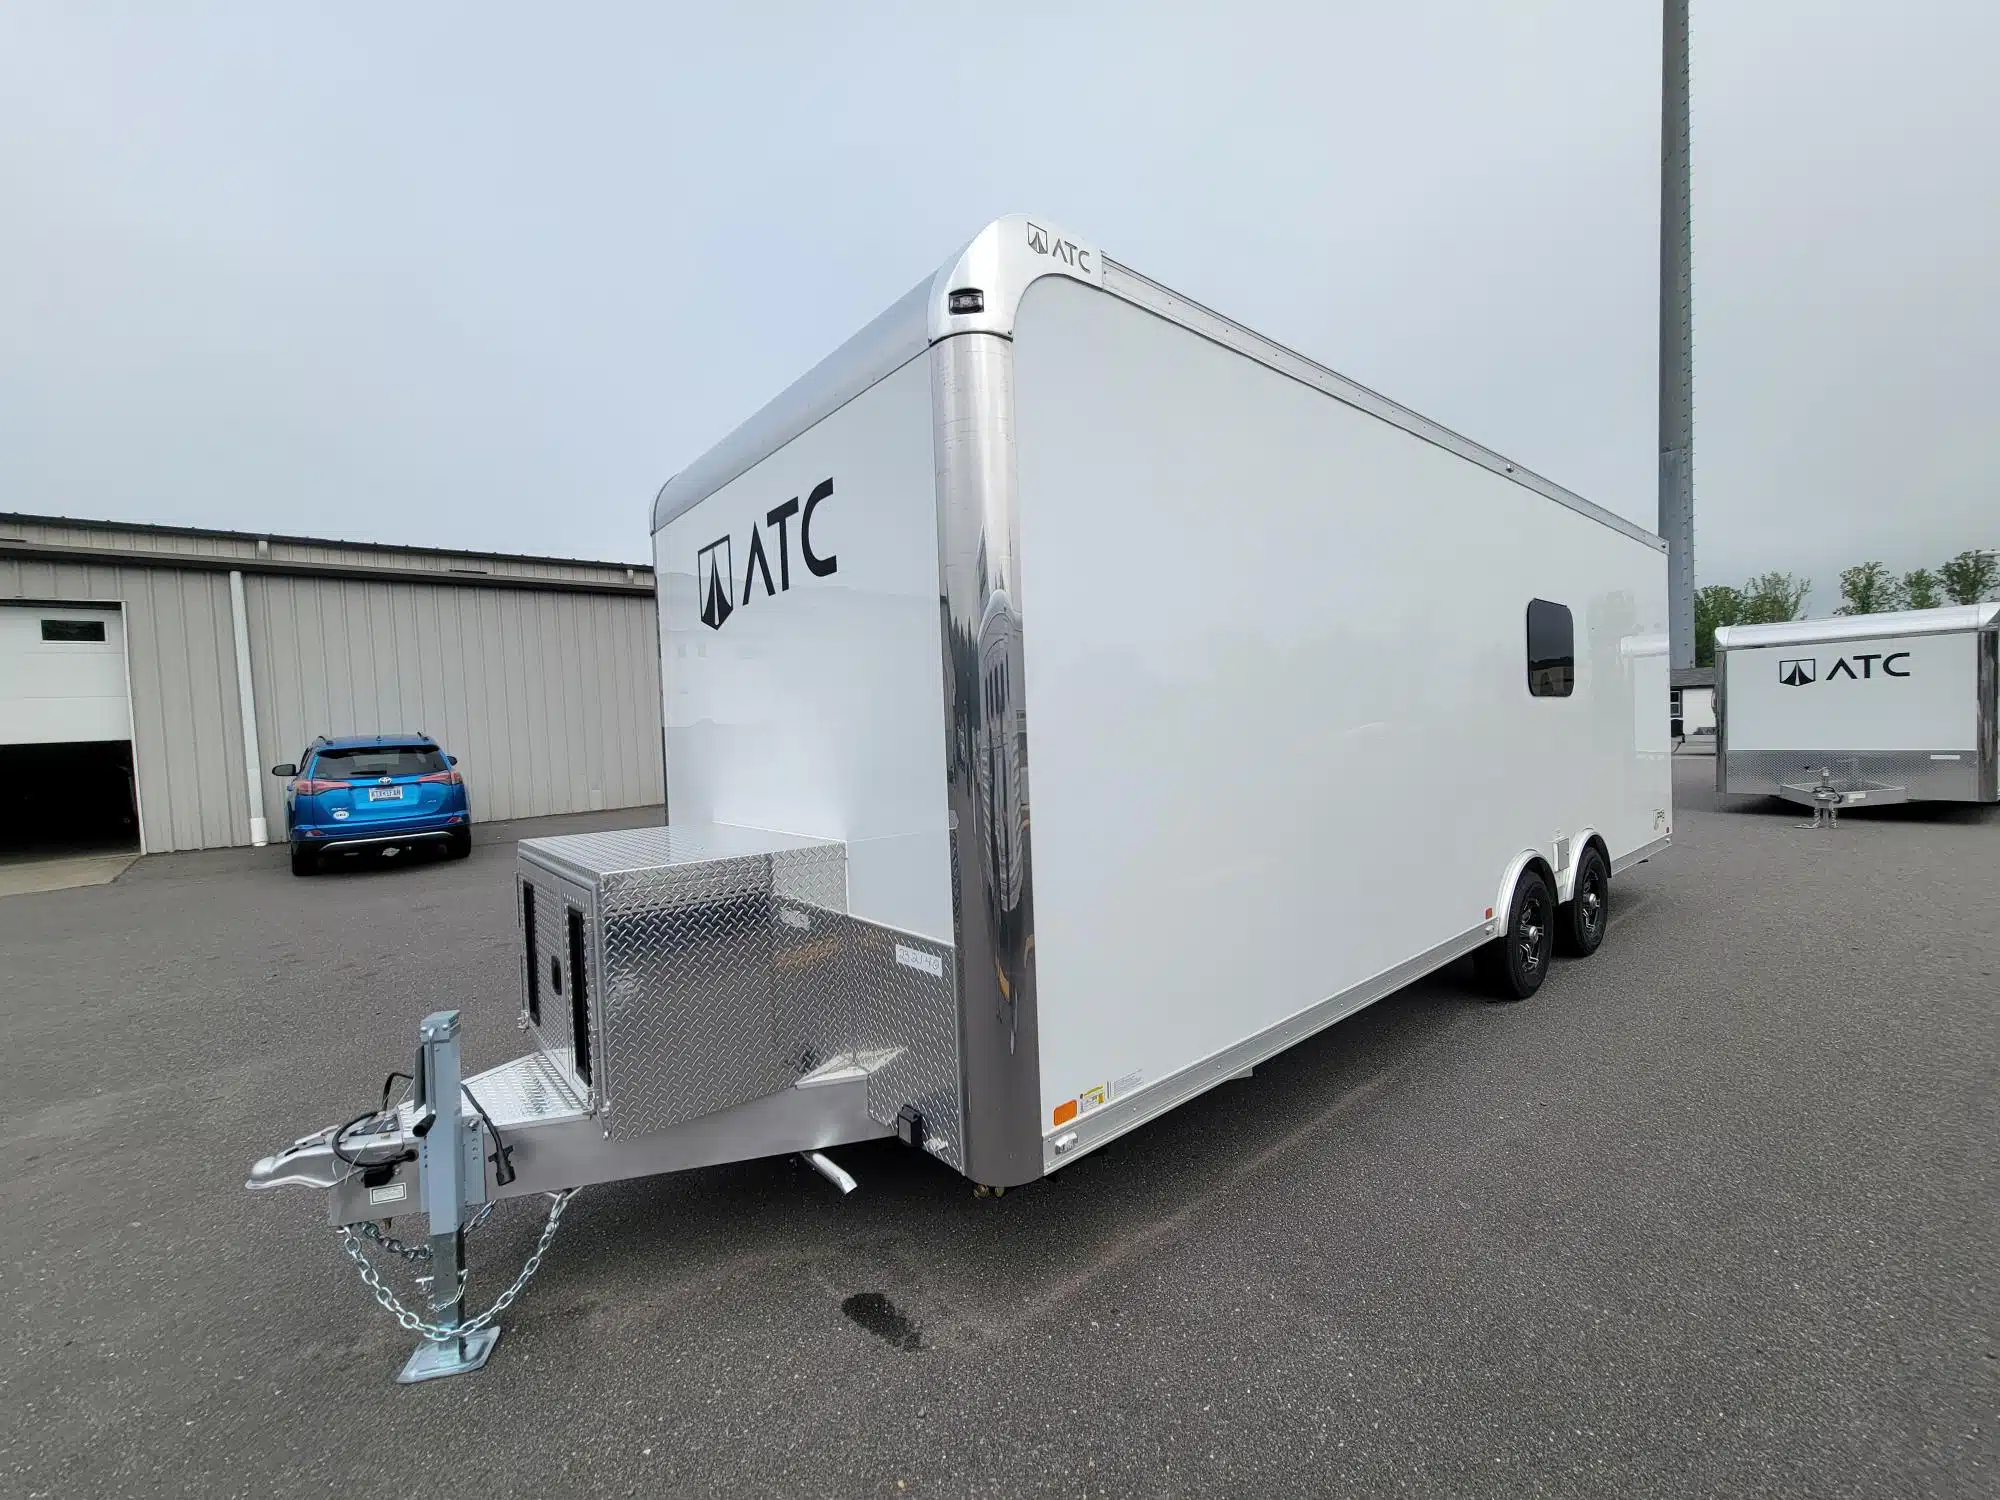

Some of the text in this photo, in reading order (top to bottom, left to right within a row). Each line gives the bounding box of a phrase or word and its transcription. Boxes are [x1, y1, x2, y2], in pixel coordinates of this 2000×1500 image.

[1052, 238, 1091, 274] ATC
[742, 477, 837, 606] ATC
[1826, 652, 1911, 681] ATC
